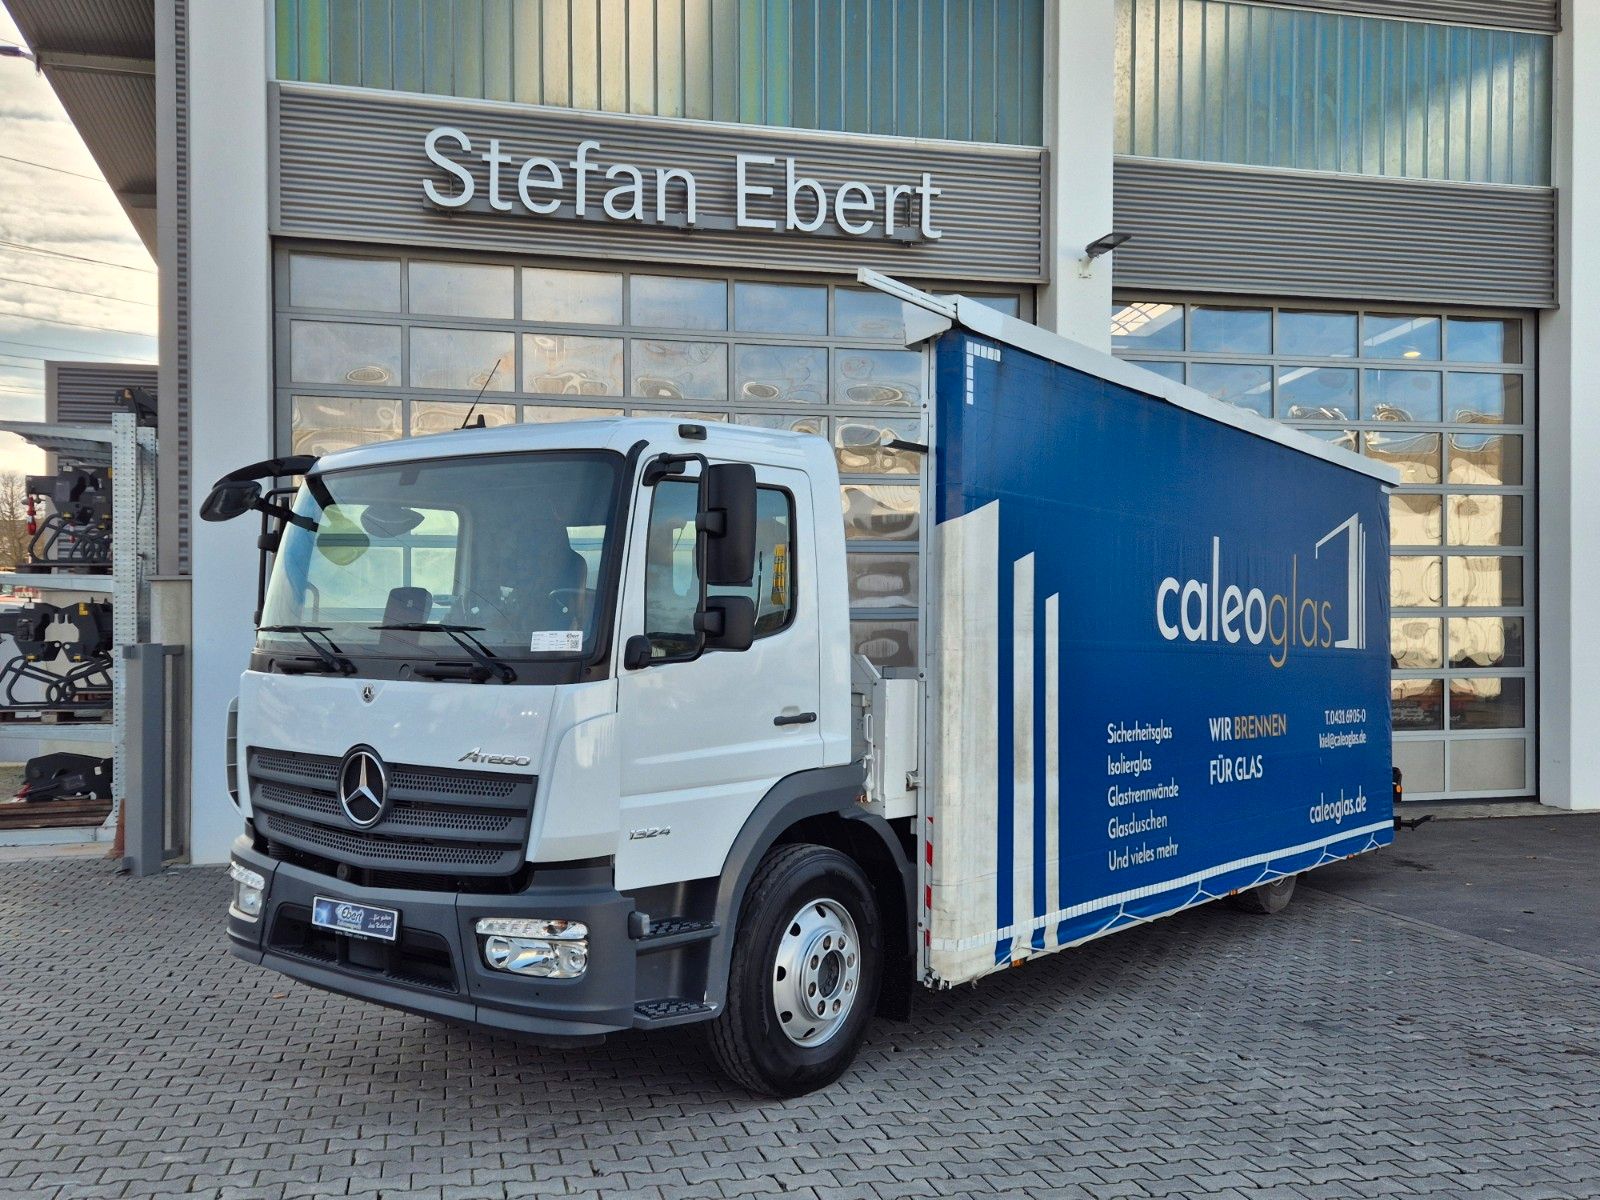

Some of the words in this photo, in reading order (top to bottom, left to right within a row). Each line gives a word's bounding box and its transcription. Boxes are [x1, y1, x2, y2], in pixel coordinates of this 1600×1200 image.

[422, 126, 697, 225] Stefan
[735, 154, 943, 239] Ebert
[1156, 536, 1332, 668] caleoglas
[1107, 718, 1173, 744] Sicherheitsglas
[1209, 717, 1232, 741] WIR
[1234, 713, 1287, 740] BRENNEN
[1107, 750, 1152, 777] Isolierglas
[1209, 754, 1233, 785] FÜR
[1235, 754, 1263, 781] GLAS
[1108, 777, 1179, 807] Glastrennwände
[1309, 785, 1367, 824] caleoglas.de
[629, 824, 672, 841] 1324
[1108, 809, 1168, 839] Glasduschen
[1108, 846, 1129, 871] Und
[1131, 842, 1154, 865] vieles
[1156, 836, 1179, 859] mehr
